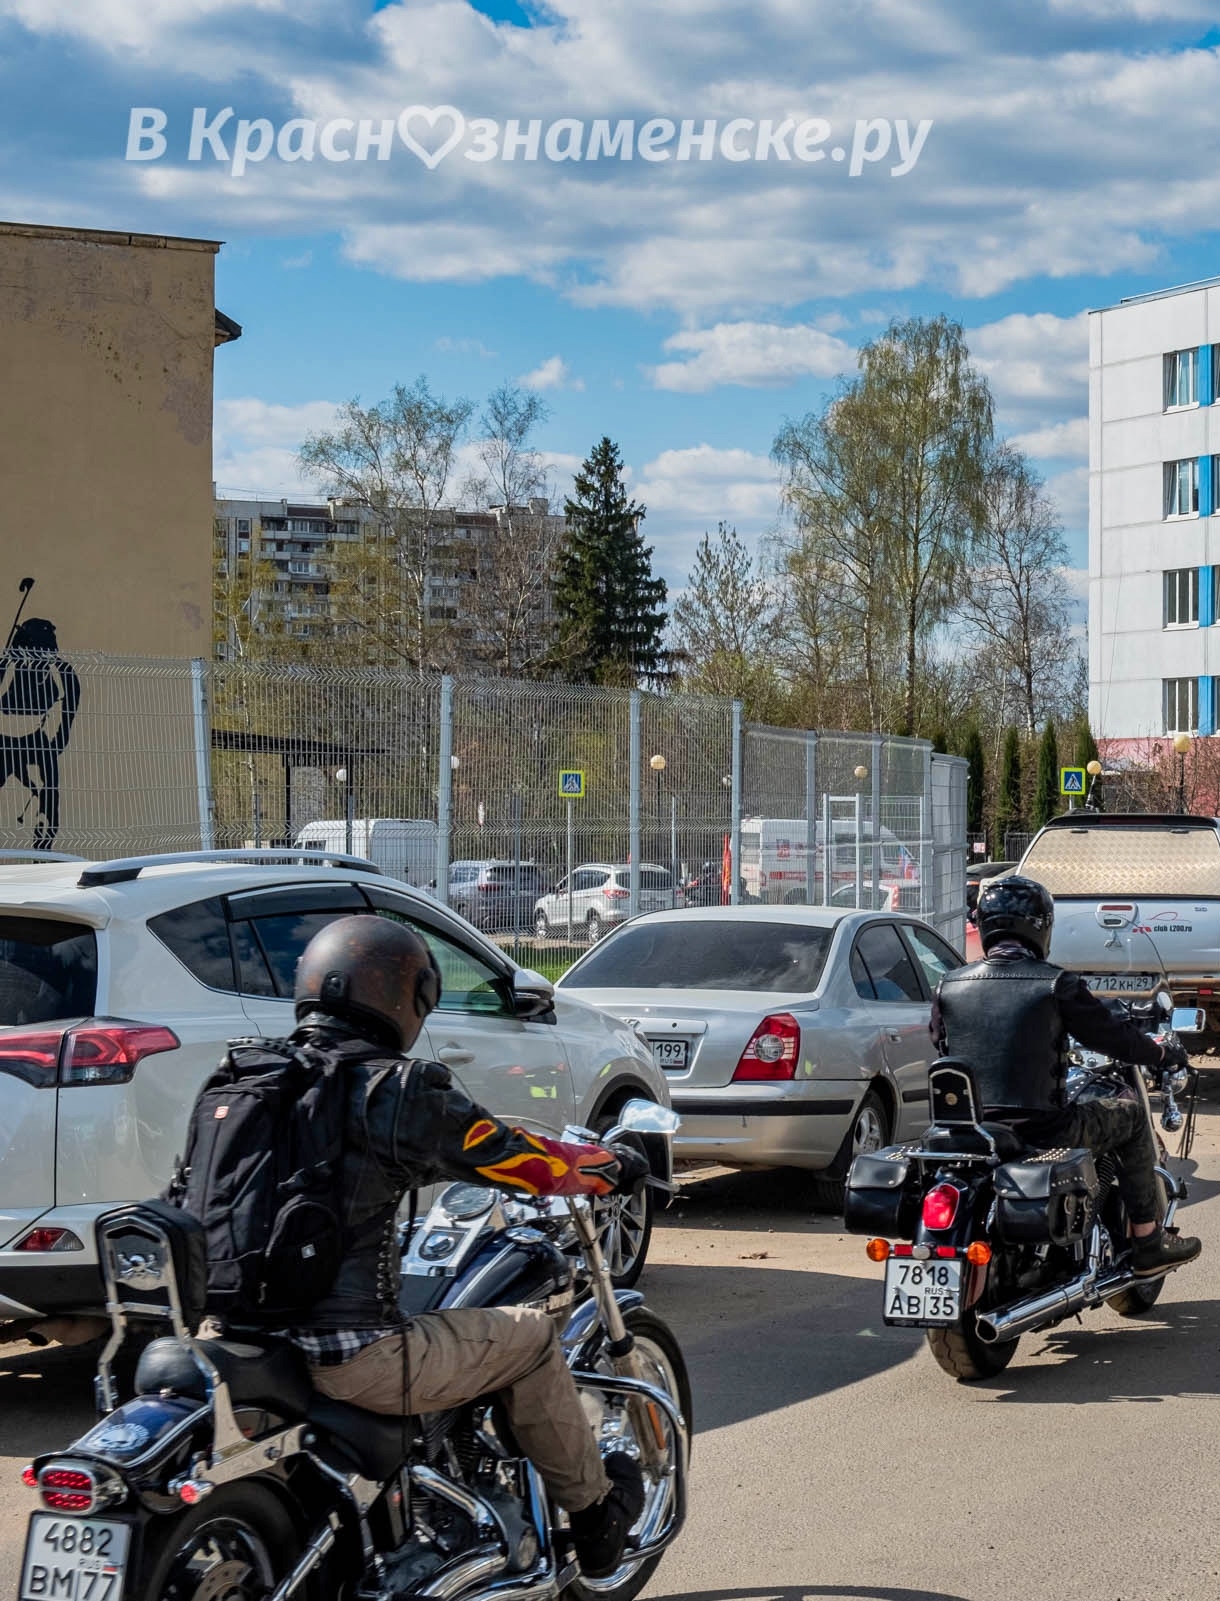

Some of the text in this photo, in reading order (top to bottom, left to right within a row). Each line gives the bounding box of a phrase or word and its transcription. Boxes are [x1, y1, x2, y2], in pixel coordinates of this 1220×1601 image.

[1136, 978, 1149, 988] 29
[656, 1044, 682, 1058] 199
[898, 1265, 949, 1286] 7818
[924, 1287, 944, 1295] RUS
[889, 1294, 954, 1316] АВ 35
[44, 1522, 113, 1557] 4882
[30, 1565, 117, 1601] ВМ 77
